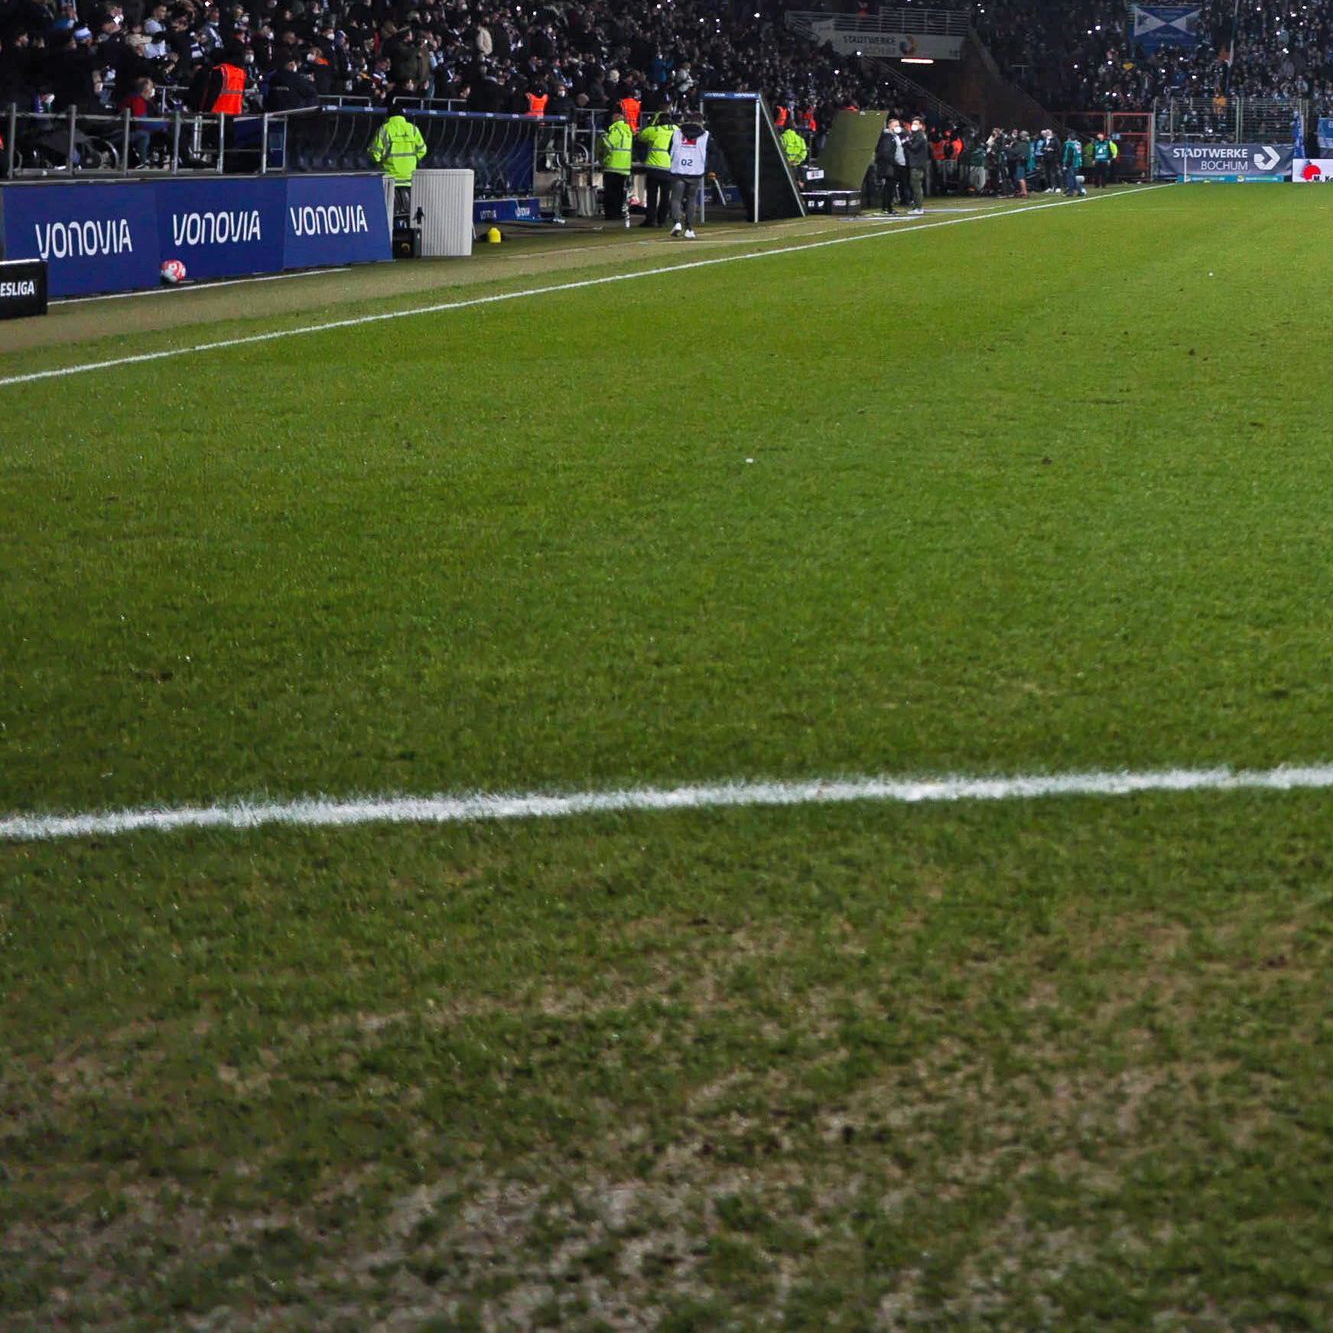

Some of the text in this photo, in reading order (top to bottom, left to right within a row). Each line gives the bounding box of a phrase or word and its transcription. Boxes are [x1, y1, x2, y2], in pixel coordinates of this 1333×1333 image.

[1172, 148, 1248, 158] STADTWERKE
[1201, 161, 1248, 171] BOCHUM
[172, 210, 261, 246] VONOVIA
[290, 204, 369, 236] VONOVIA
[35, 218, 133, 259] VONOVIA
